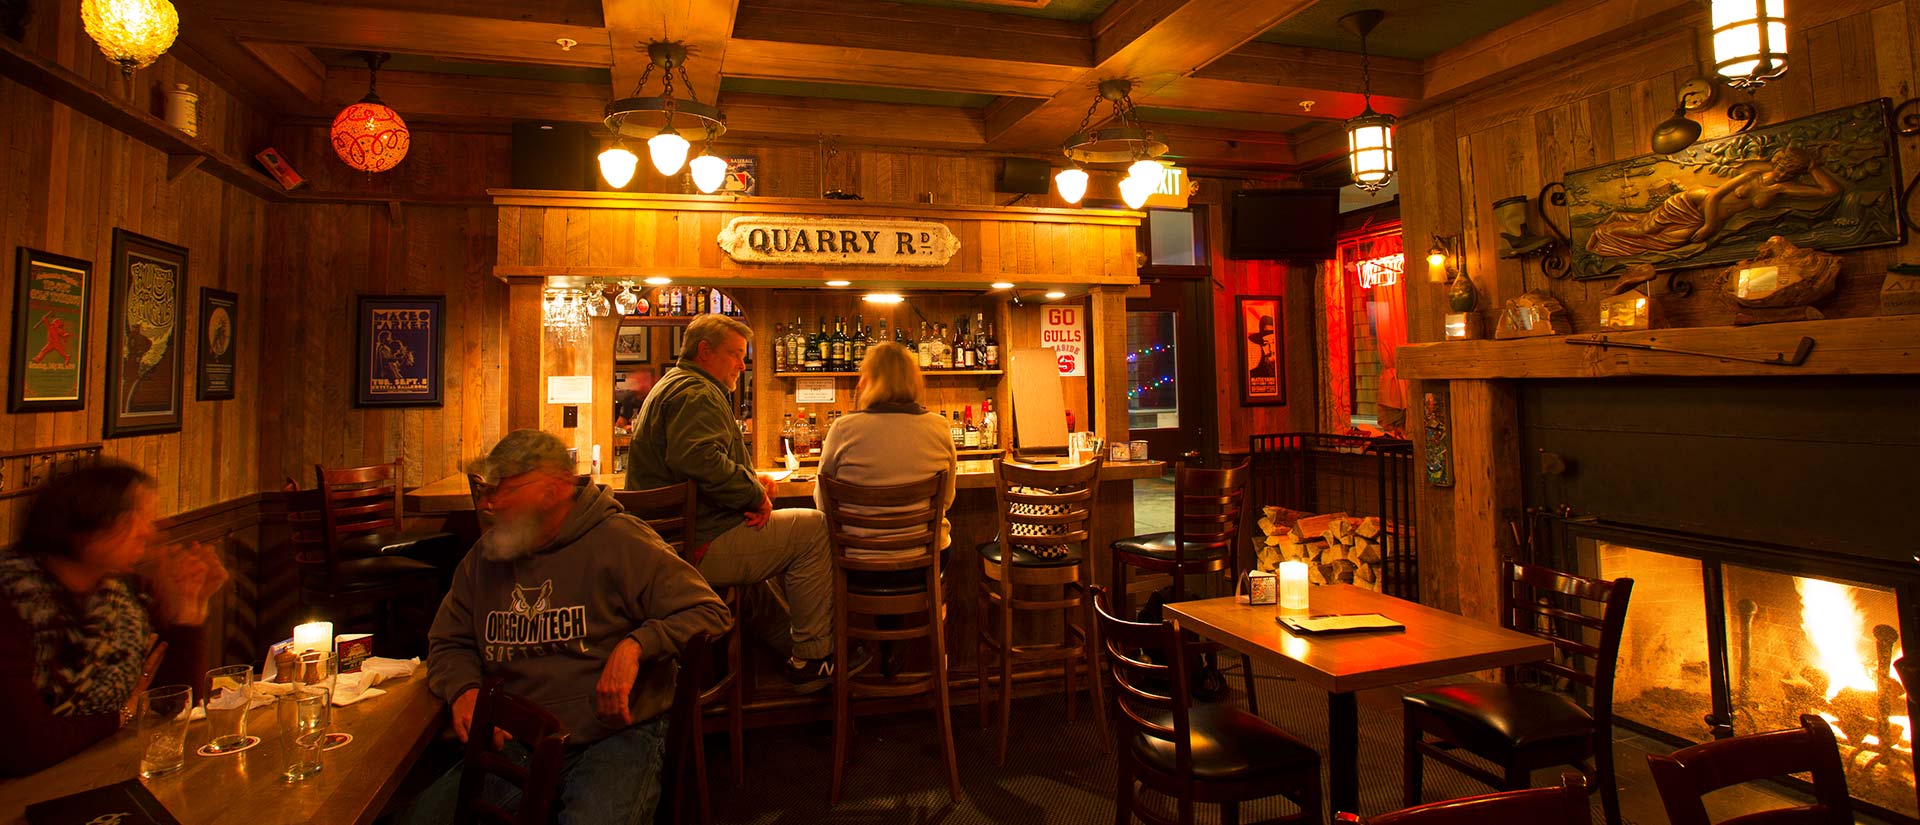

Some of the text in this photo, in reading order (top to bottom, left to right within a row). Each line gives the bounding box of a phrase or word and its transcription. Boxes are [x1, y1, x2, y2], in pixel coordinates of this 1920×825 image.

[748, 228, 880, 255] QUARRY
[374, 311, 429, 321] MACEO
[1048, 308, 1075, 326] GO
[374, 321, 429, 330] PARKER
[1043, 330, 1082, 343] GULLS
[1050, 344, 1081, 356] ASIDE
[485, 605, 587, 645] OREGON TECH
